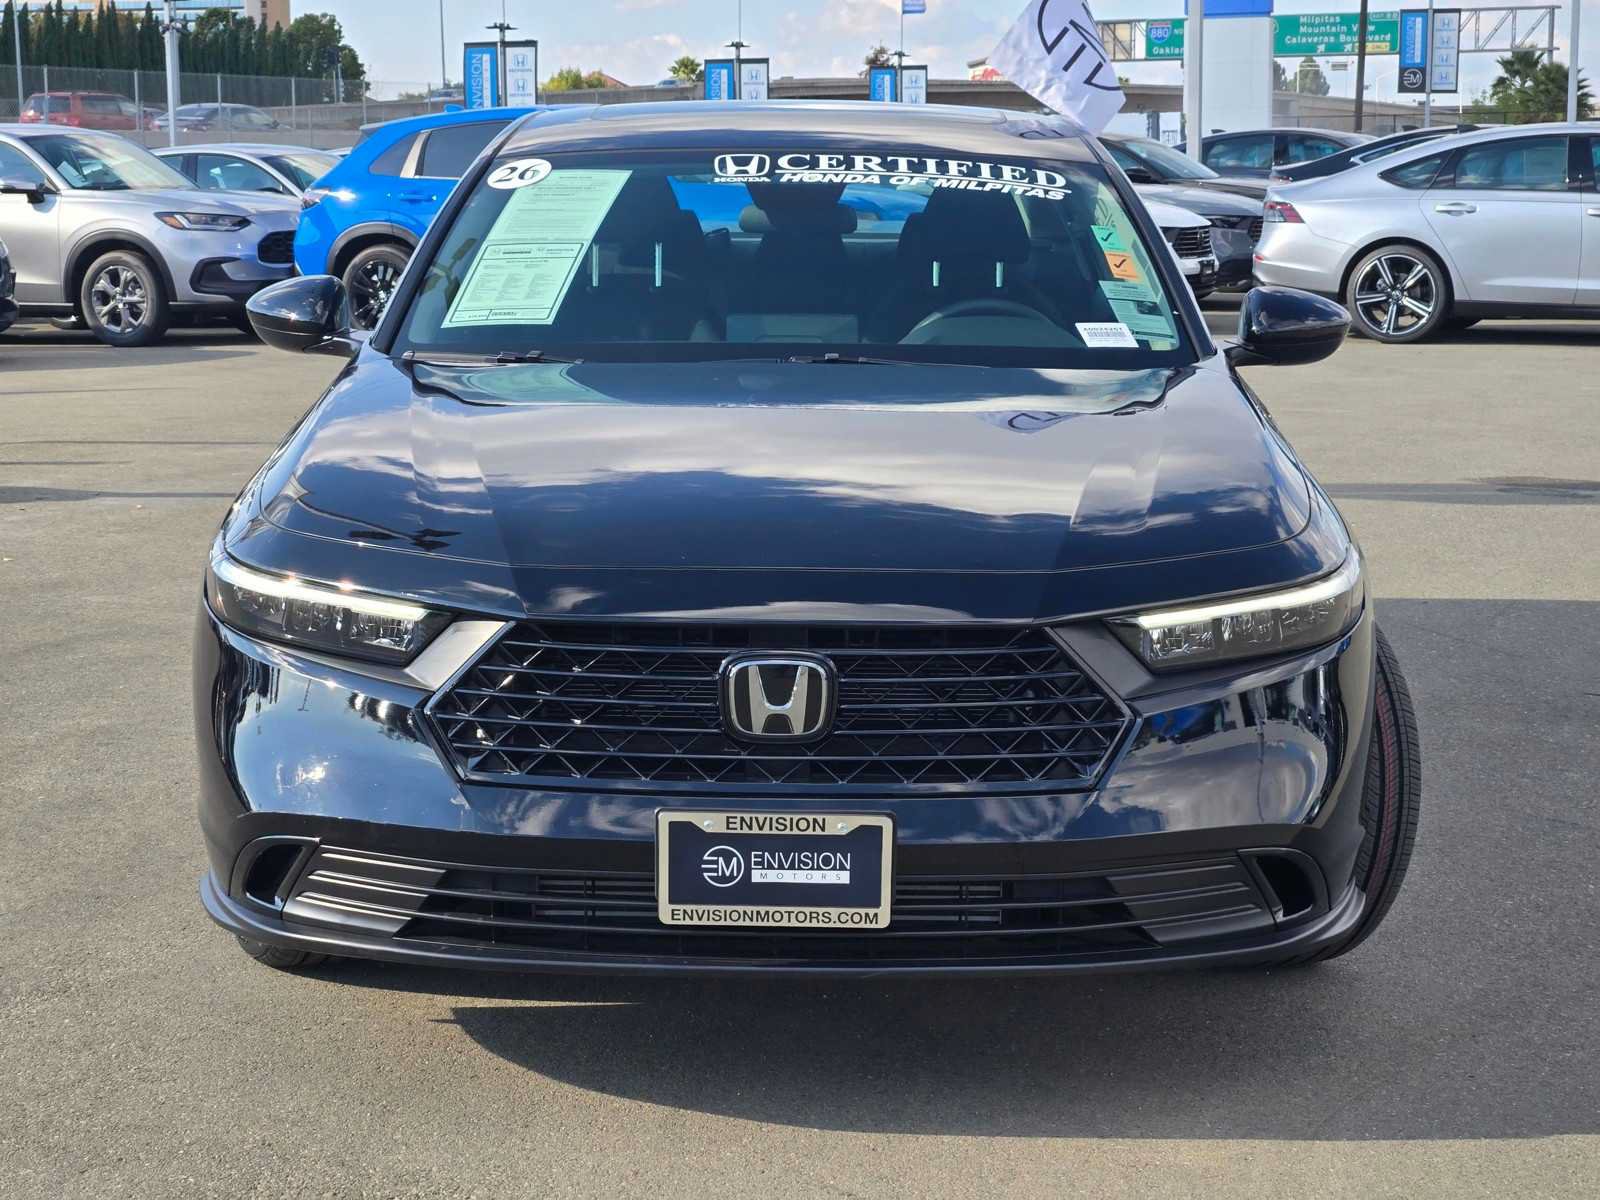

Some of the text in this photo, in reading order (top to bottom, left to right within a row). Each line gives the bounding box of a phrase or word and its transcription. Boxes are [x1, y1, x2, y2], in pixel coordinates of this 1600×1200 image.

[1299, 15, 1341, 24] Milpitas
[1299, 23, 1376, 33] Mountain Vw
[1150, 28, 1169, 38] 880
[1284, 33, 1391, 44] Calaveras Bouvard
[492, 162, 543, 184] 26
[777, 153, 1068, 188] CERTIFIED
[779, 173, 1066, 201] HONDA OF MILPITAS
[725, 815, 827, 833] ENVISION
[751, 851, 851, 870] ENVISION
[759, 872, 841, 881] MOTORS
[670, 908, 879, 925] ENVISIONMOTORS.COM
